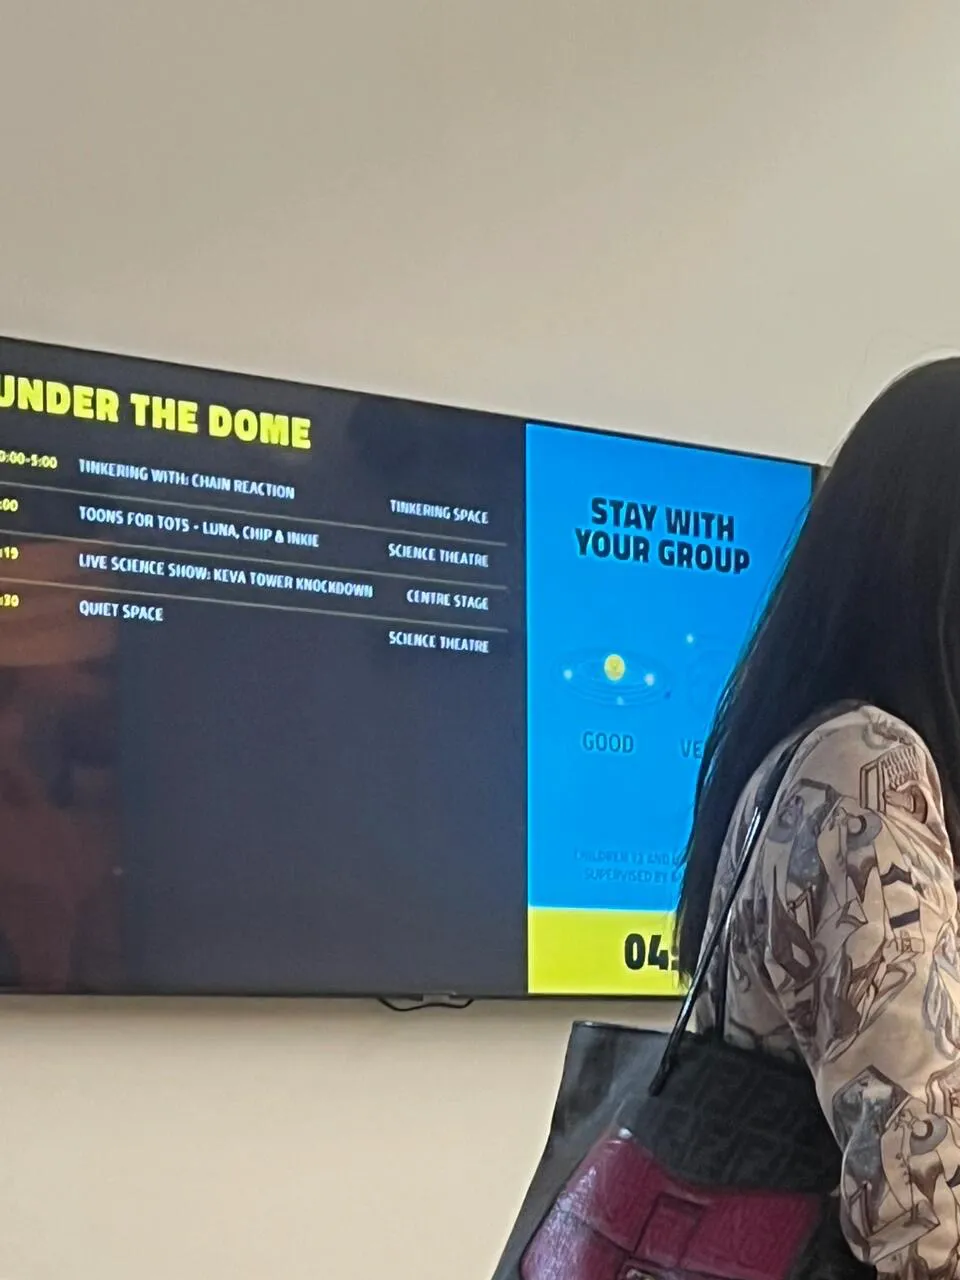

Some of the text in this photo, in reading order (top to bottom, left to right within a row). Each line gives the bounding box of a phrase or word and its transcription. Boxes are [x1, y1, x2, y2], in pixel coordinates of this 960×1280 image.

[0, 374, 311, 449] UNDER THE DOME
[79, 458, 148, 480] TINKERING
[192, 473, 231, 491] CHAIN
[233, 479, 295, 499] REACTION
[79, 506, 123, 525] TOONS
[128, 512, 154, 528] FOR
[158, 515, 189, 532] TOTS
[203, 521, 240, 540] LUNA,
[242, 525, 273, 542] CHIP
[287, 531, 319, 548] INKIE
[390, 500, 489, 524] TINKERING SPACE
[591, 497, 734, 542] STAY WITH
[388, 543, 489, 568] SCIENCE THEATRE
[575, 528, 750, 574] YOUR GROUP
[79, 554, 107, 570] LIVE
[111, 557, 164, 576] SCIENCE
[213, 568, 247, 585] KEVA
[250, 571, 293, 589] TOWER
[296, 577, 373, 598] KNOCKDOWN
[79, 600, 163, 622] QUIET SPACE
[406, 590, 489, 611] CENTRE STAGE
[388, 631, 489, 654] SCIENCE THEATRE
[583, 731, 634, 754] GOOD
